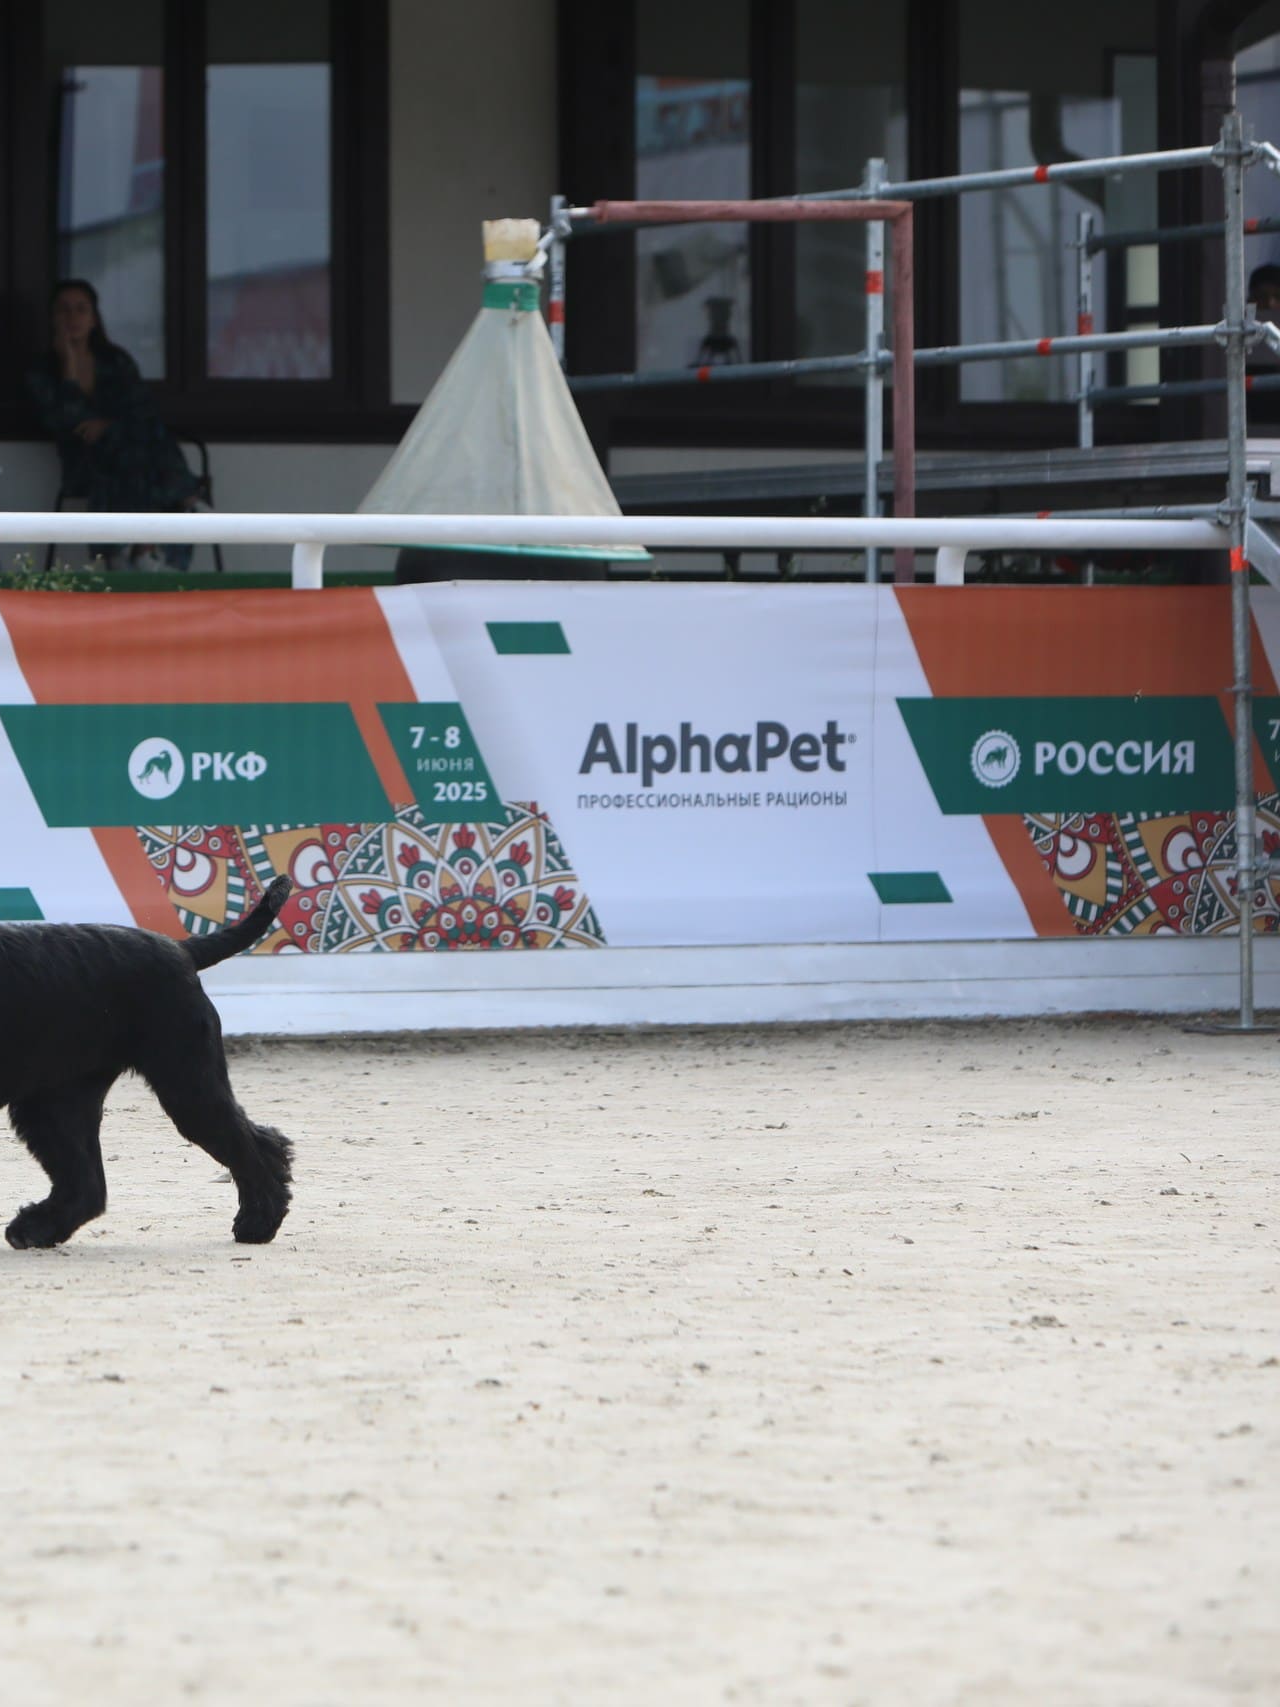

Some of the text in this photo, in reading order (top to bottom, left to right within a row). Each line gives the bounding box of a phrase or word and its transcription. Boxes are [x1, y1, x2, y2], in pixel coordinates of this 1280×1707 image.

[192, 752, 268, 781] РКФ
[1035, 741, 1195, 776] РОССИЯ
[433, 782, 488, 802] 2025
[578, 792, 848, 809] ПРОФЕССИОНАЛЬНЫЕ РАЦИОНЫ
